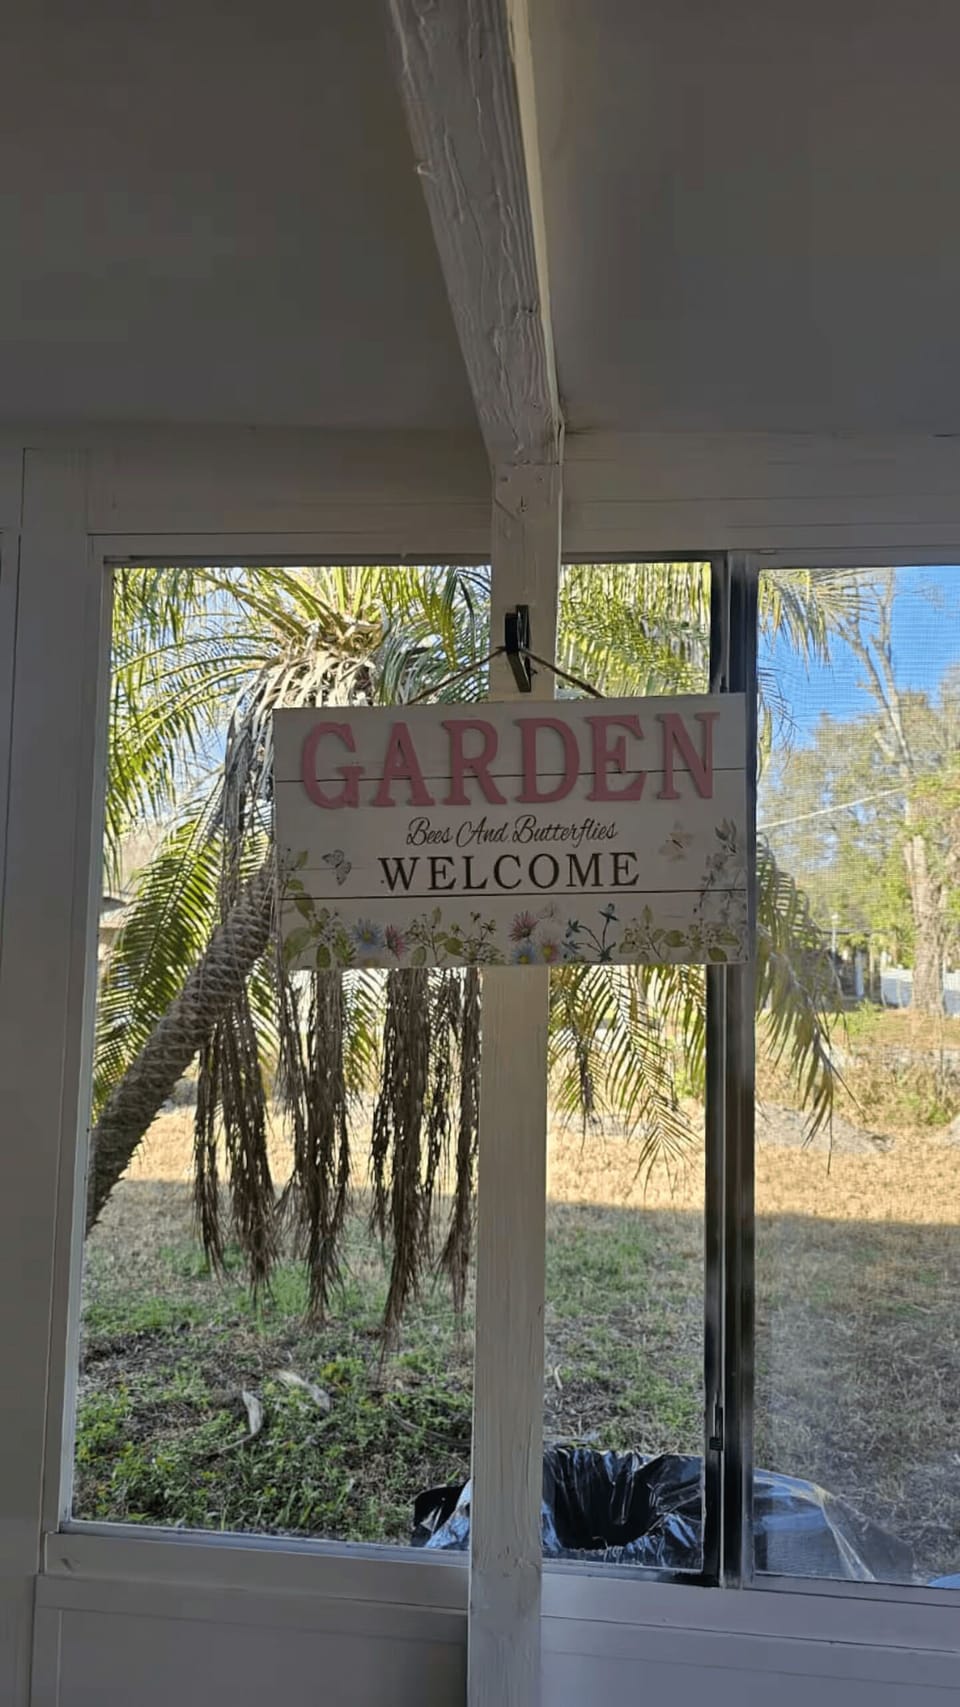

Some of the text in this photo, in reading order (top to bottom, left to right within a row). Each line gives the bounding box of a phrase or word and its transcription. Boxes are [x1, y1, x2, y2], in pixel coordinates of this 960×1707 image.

[302, 711, 721, 809] GARDEN
[405, 814, 618, 848] Bees And Butterflies
[378, 851, 640, 891] WELCOME
